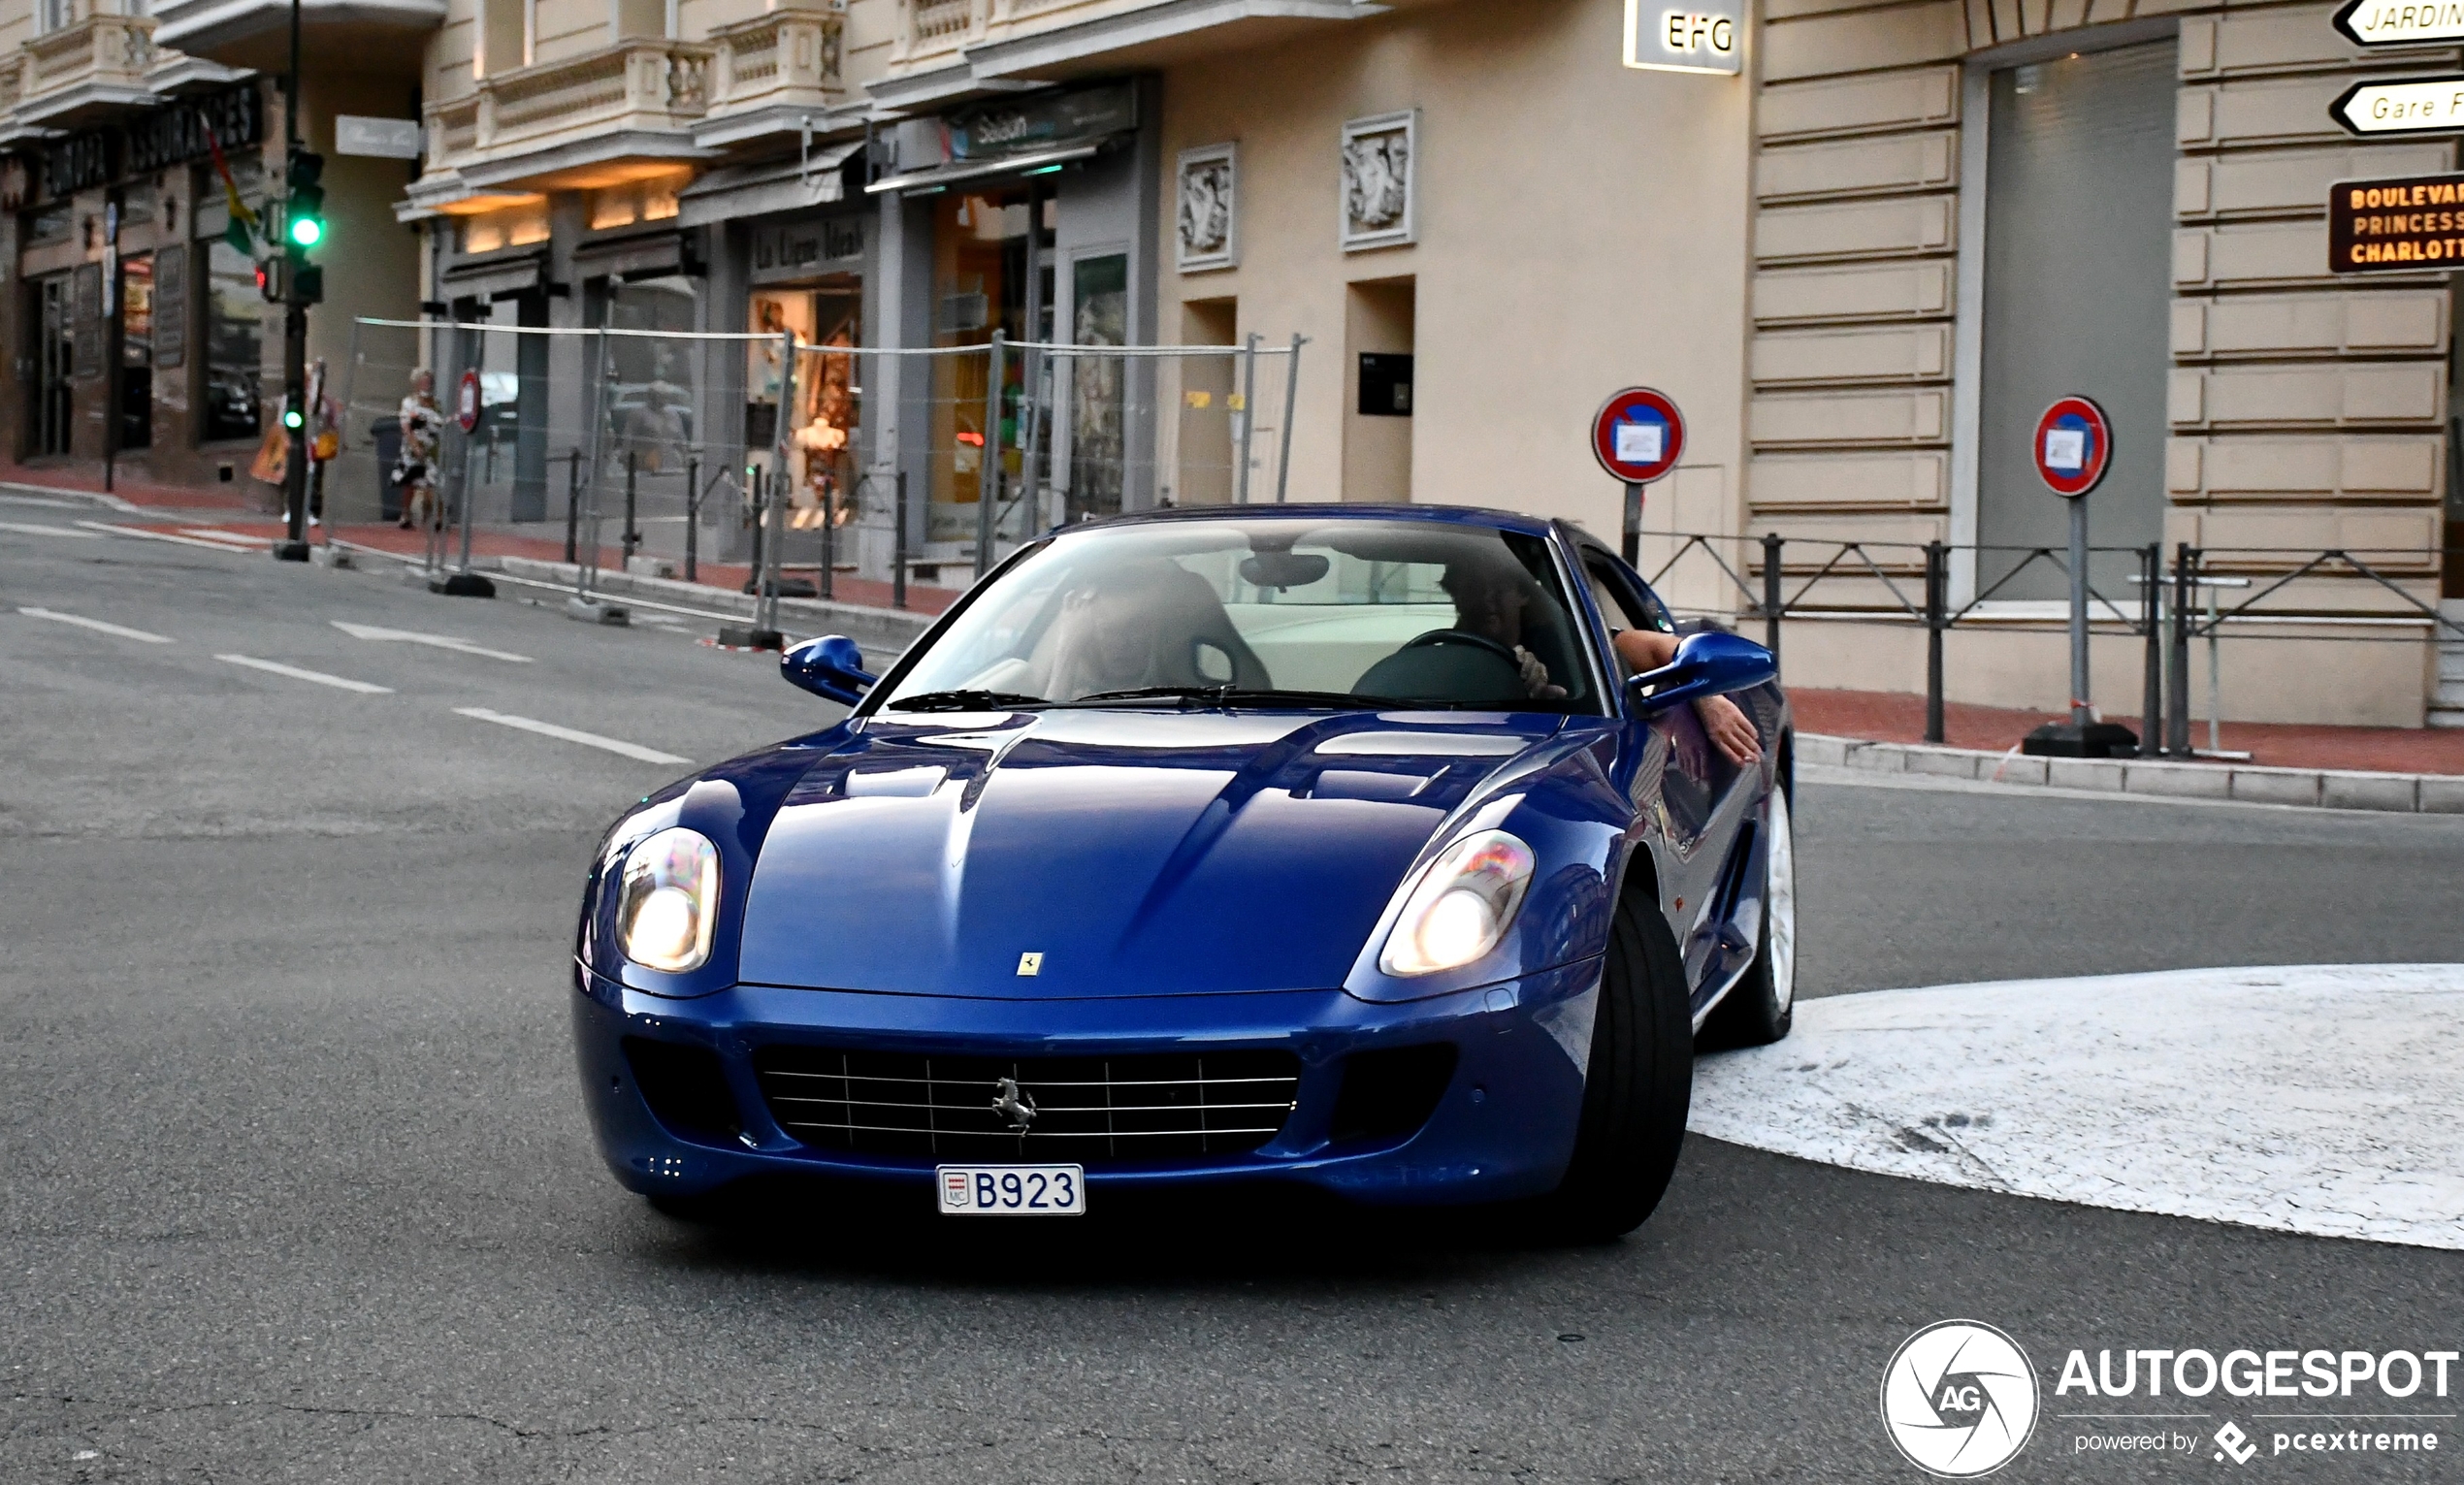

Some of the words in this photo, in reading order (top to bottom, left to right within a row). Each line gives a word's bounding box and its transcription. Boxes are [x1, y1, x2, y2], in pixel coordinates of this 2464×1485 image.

[2365, 3, 2464, 31] JARDIN
[1670, 15, 1732, 51] EFG
[2373, 97, 2435, 119] Gare
[2353, 210, 2464, 236] PRINCESS
[975, 1172, 1075, 1209] B923
